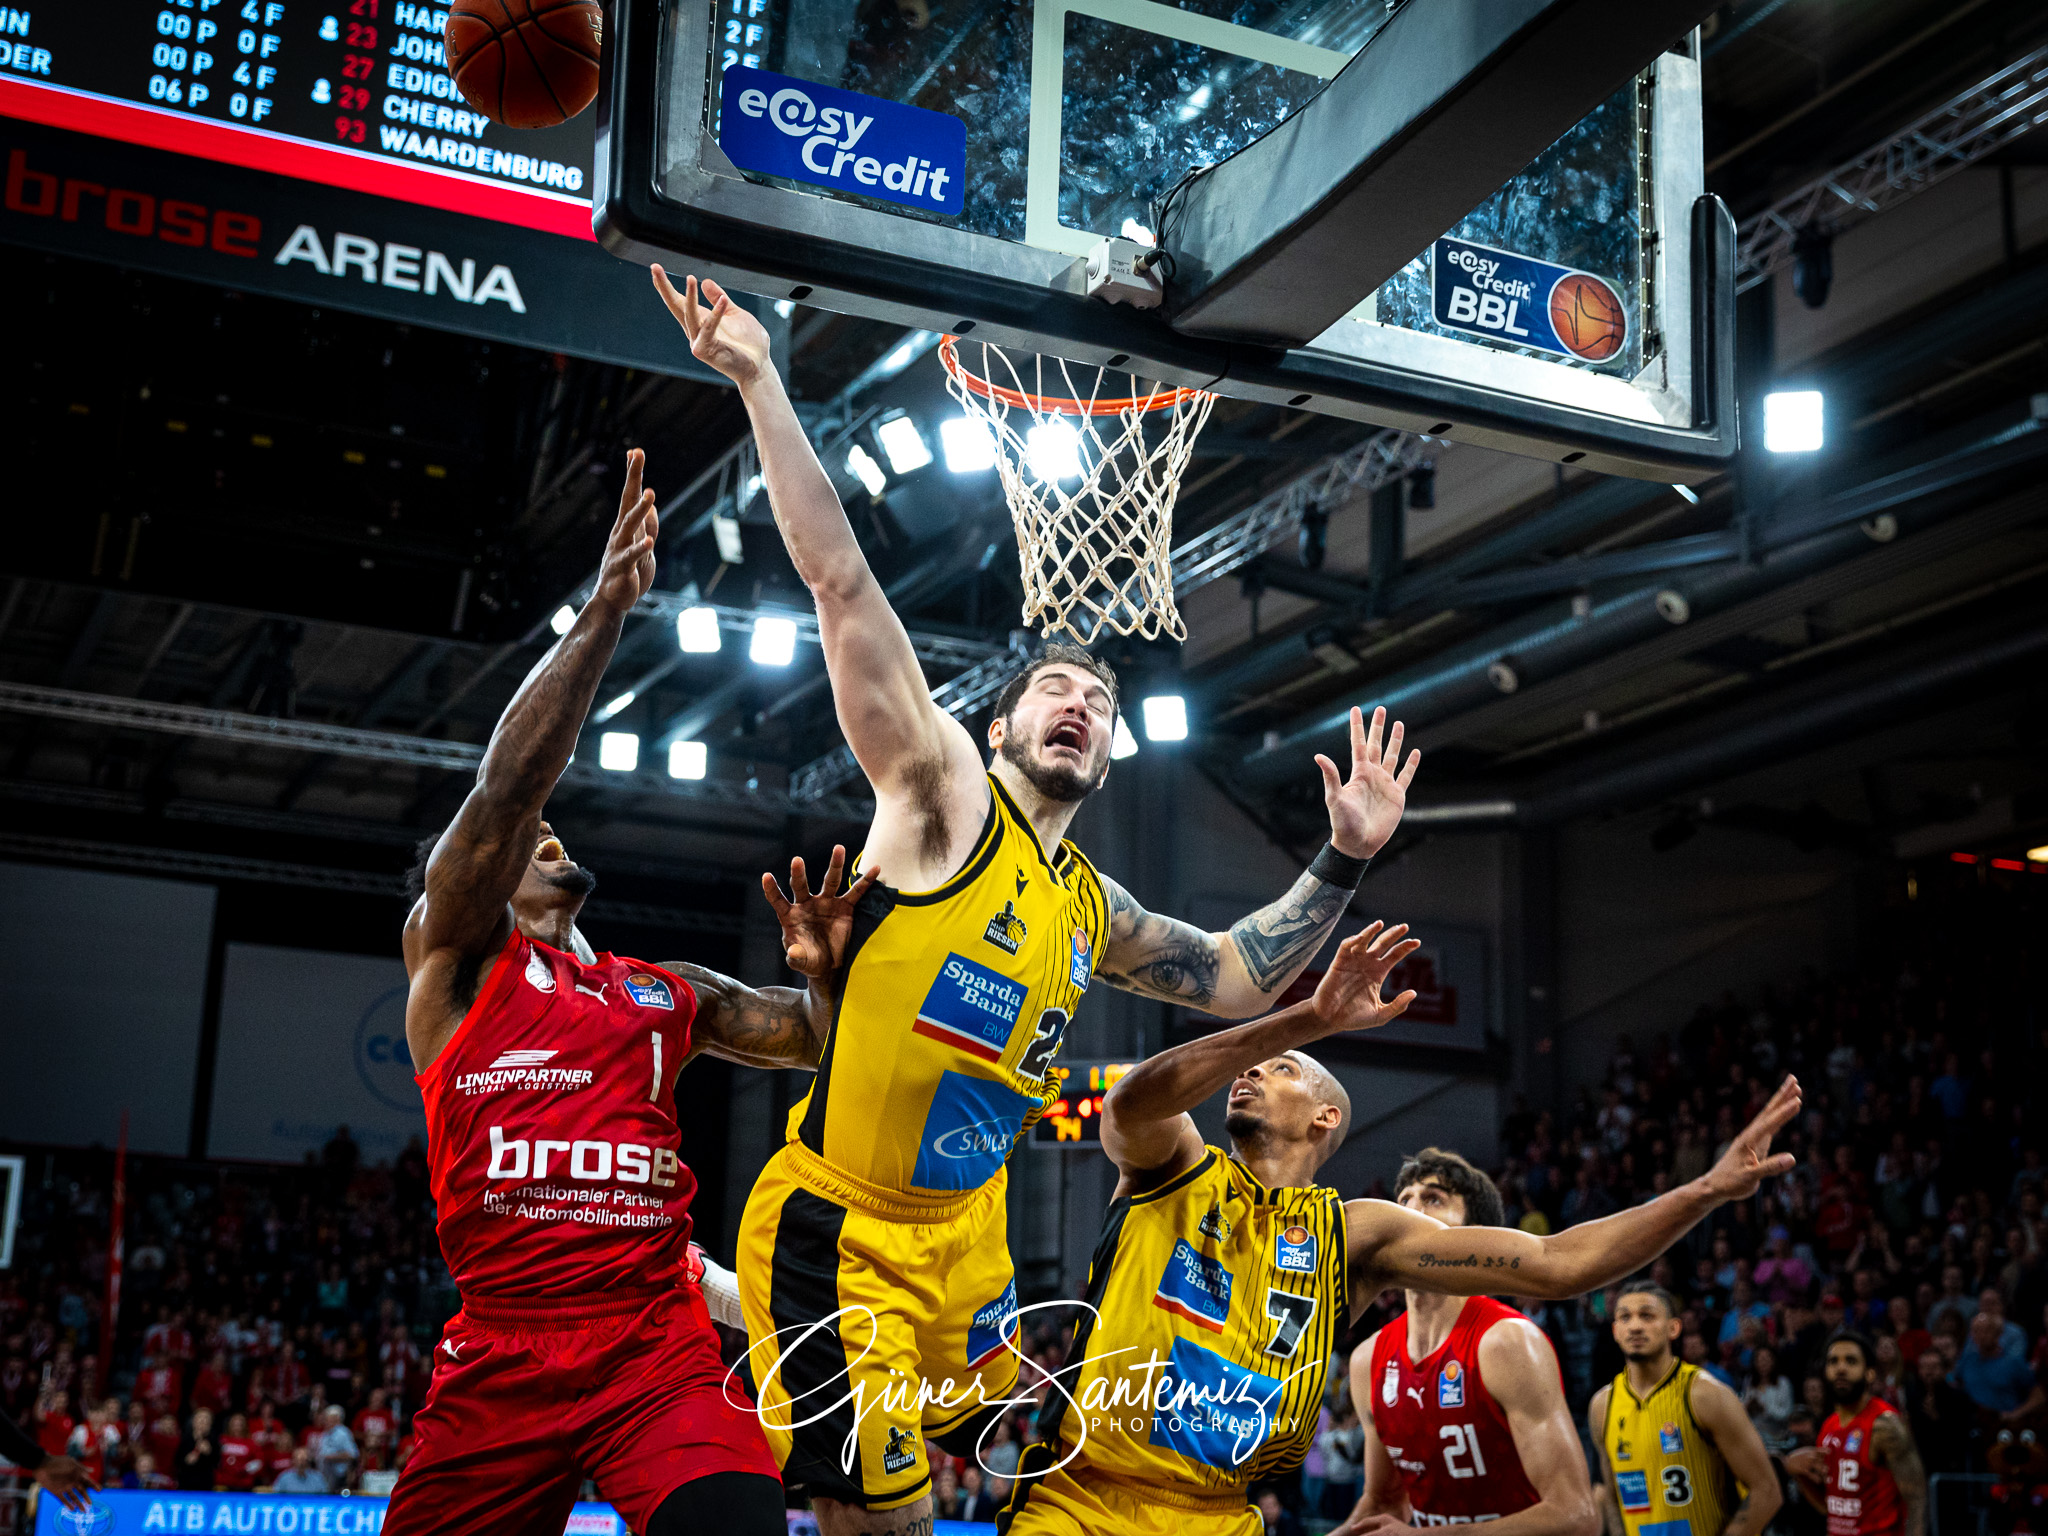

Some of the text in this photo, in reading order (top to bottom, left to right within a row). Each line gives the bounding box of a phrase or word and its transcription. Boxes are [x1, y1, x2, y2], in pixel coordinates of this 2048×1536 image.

[264, 2, 285, 27] F
[156, 10, 192, 39] 00
[196, 19, 218, 44] P
[237, 29, 256, 54] 0
[260, 33, 281, 59] F
[346, 22, 378, 49] 23
[725, 19, 763, 47] 2 F
[152, 42, 188, 71] 00
[192, 51, 214, 76] P
[232, 61, 252, 86] 4
[256, 64, 277, 90] F
[341, 54, 375, 80] 27
[148, 74, 183, 103] 06
[188, 82, 209, 108] P
[228, 92, 248, 118] 0
[252, 96, 274, 122] F
[338, 84, 371, 111] 29
[383, 94, 490, 139] CHERRY
[334, 116, 583, 191] 93 WAARDENBURG
[801, 135, 950, 201] Credit
[5, 149, 527, 313] brose ARENA
[1472, 271, 1531, 300] Credit
[1447, 286, 1530, 337] BBL
[987, 927, 1018, 951] RIESEN
[638, 995, 669, 1005] BBL
[943, 960, 1021, 1008] Sparda
[960, 985, 1017, 1023] Bank
[982, 1021, 1010, 1042] BW
[456, 1069, 593, 1091] LINKINPARTNER
[649, 1031, 663, 1102] 1
[465, 1082, 581, 1096] GLOBAL LOGISTICS
[486, 1126, 678, 1188] brose
[515, 1204, 673, 1228] Automobilindustrie
[1174, 1244, 1229, 1288] Sparda
[1281, 1256, 1310, 1268] BBL
[1418, 1253, 1478, 1268] Proverbs
[1185, 1267, 1229, 1301] Bank
[1202, 1300, 1227, 1318] BW
[1264, 1287, 1317, 1359] 7
[887, 1452, 915, 1470] RIESEN
[1439, 1423, 1487, 1479] 21
[1661, 1465, 1693, 1507] 3
[1838, 1458, 1860, 1492] 12
[144, 1502, 386, 1534] ATB AUTOTECH
